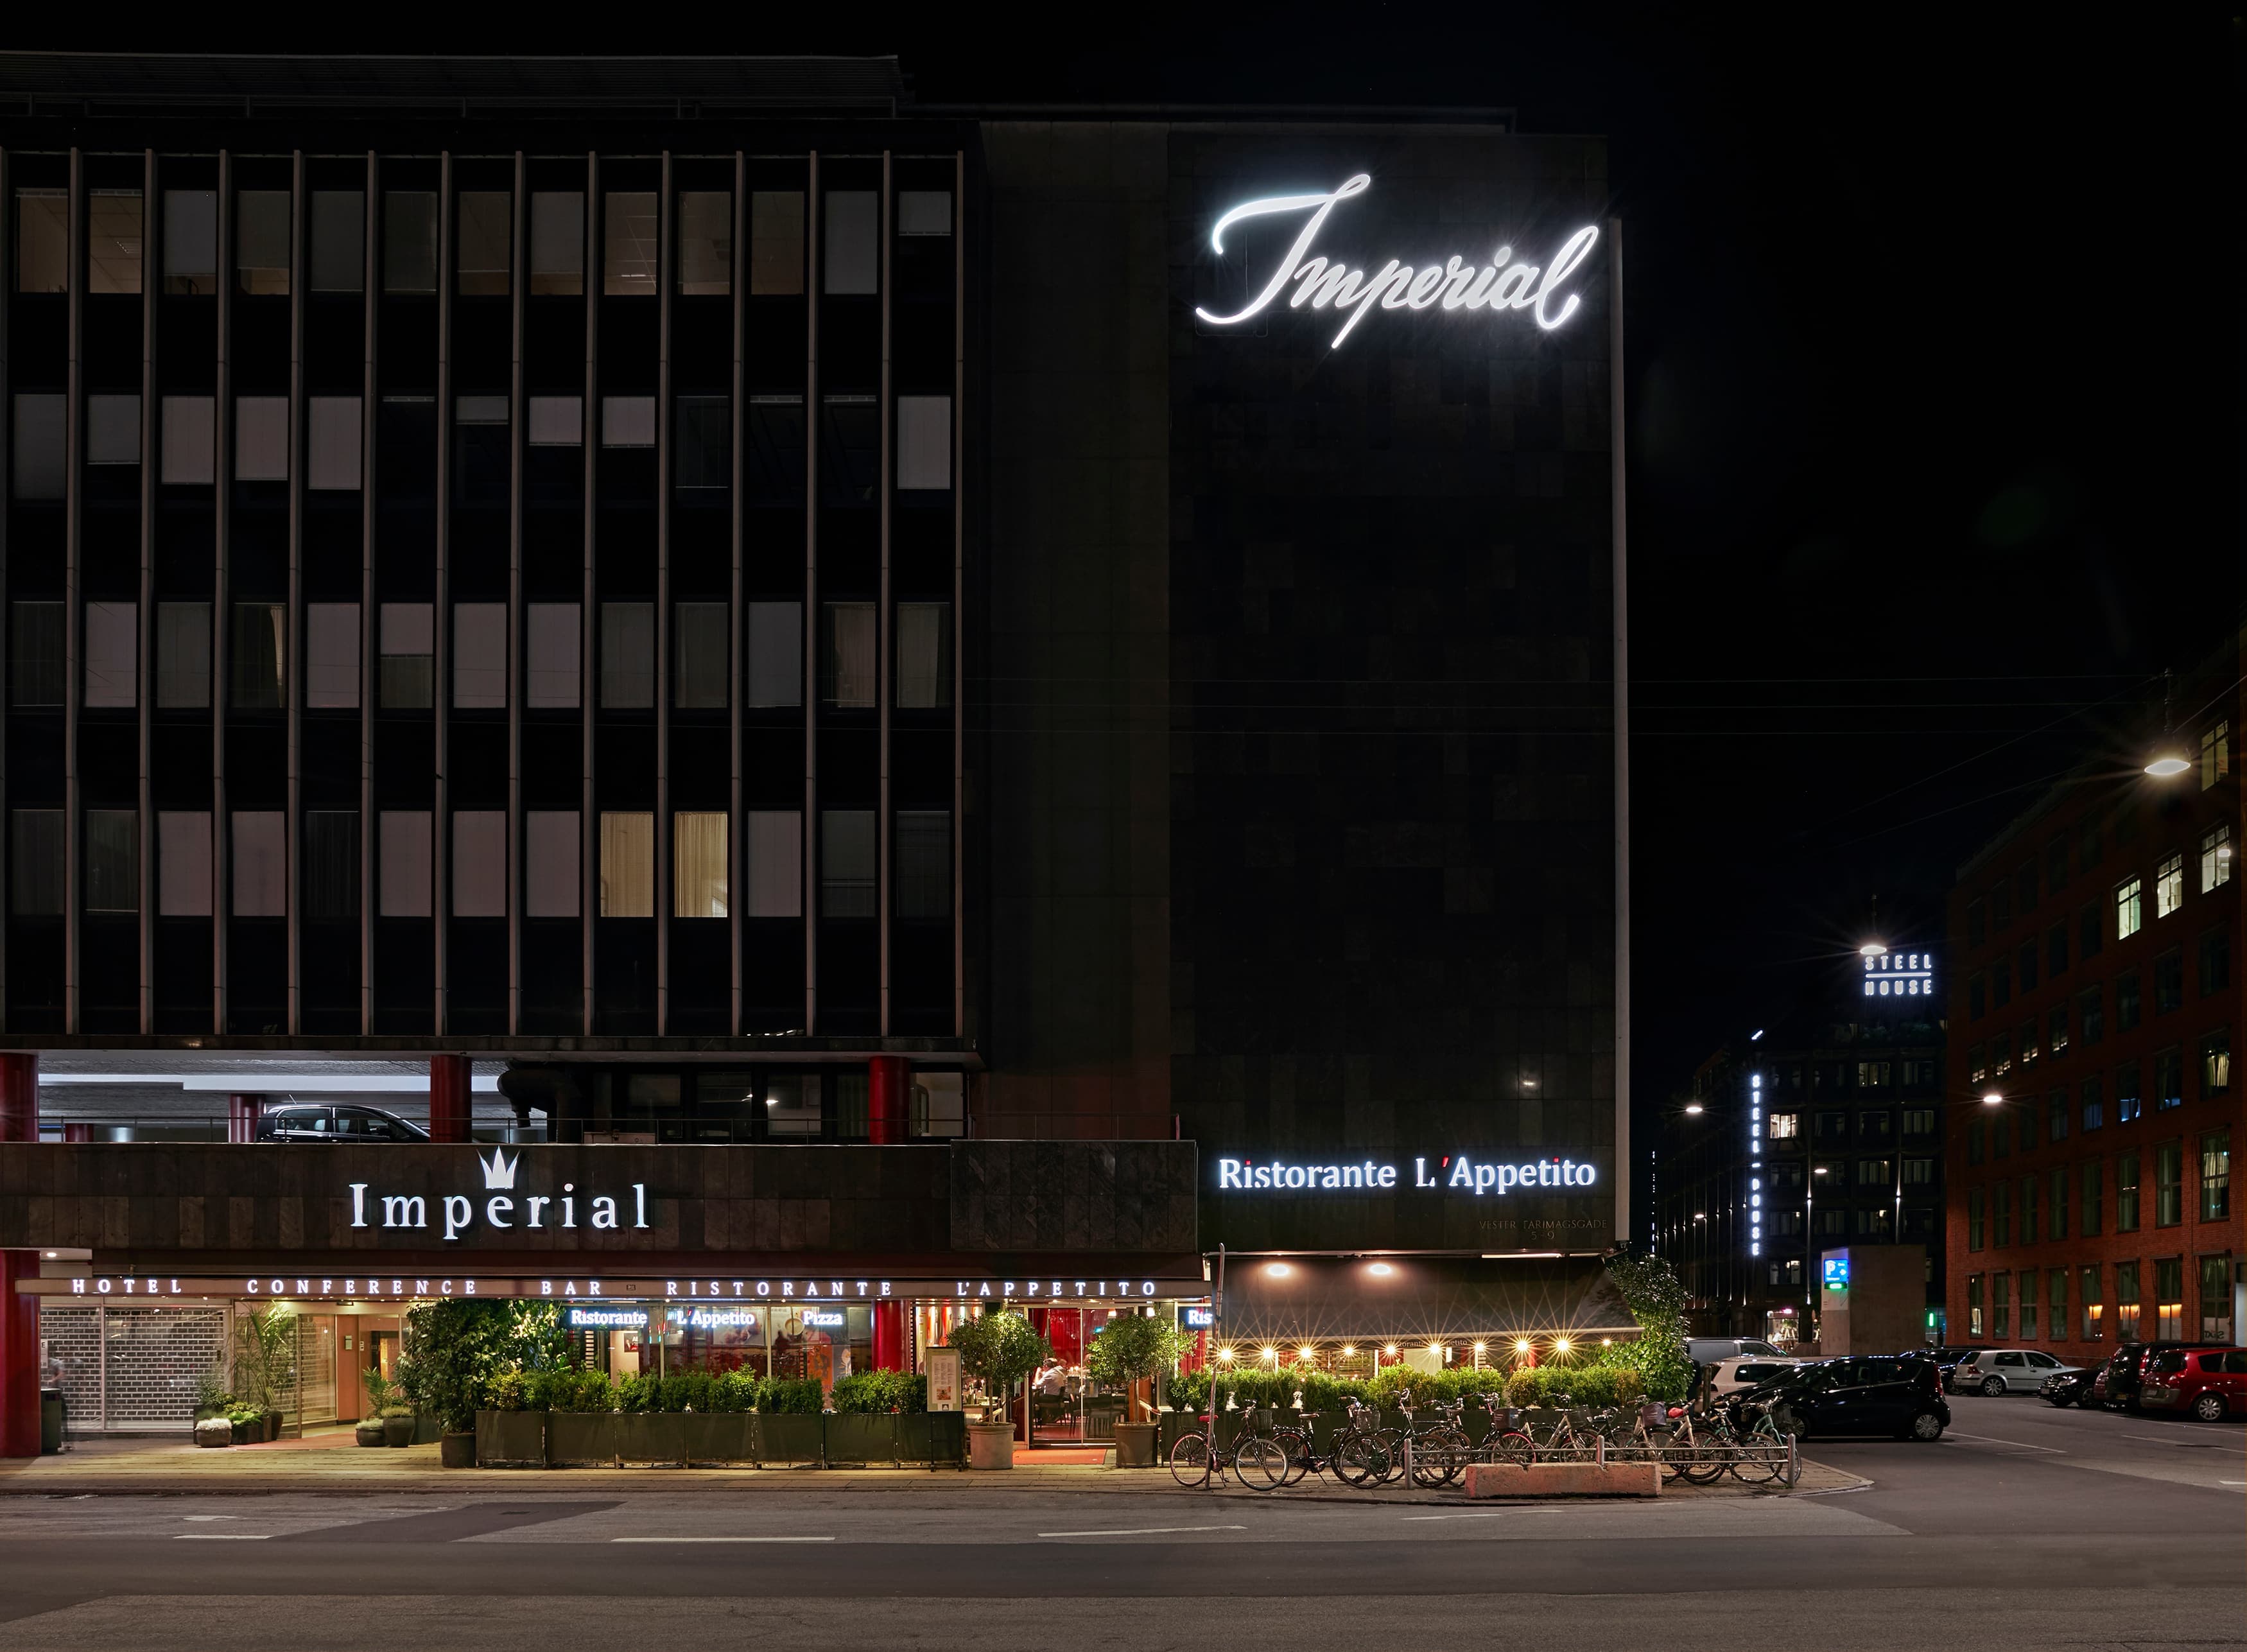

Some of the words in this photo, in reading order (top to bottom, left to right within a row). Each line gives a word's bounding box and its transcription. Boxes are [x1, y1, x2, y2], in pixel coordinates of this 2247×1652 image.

[1196, 174, 1599, 349] Imperial
[1865, 955, 1931, 970] STEEL
[1865, 980, 1931, 995] HOUSE
[1752, 1075, 1760, 1153] STEEL
[1219, 1159, 1396, 1188] Ristorante
[1416, 1157, 1595, 1195] L'Appetito
[349, 1183, 649, 1240] Imperial
[1479, 1221, 1516, 1230] VESTER
[73, 1279, 181, 1293] HOTEL
[247, 1280, 476, 1294] CONFERENCE
[541, 1281, 601, 1295] BAR
[667, 1282, 890, 1296] RISTORANTE
[957, 1282, 1155, 1296] L'APPETITO
[571, 1310, 647, 1324] Ristorante
[677, 1310, 754, 1328] L'Appetito
[803, 1310, 842, 1325] Pizza
[1188, 1310, 1213, 1324] Ris
